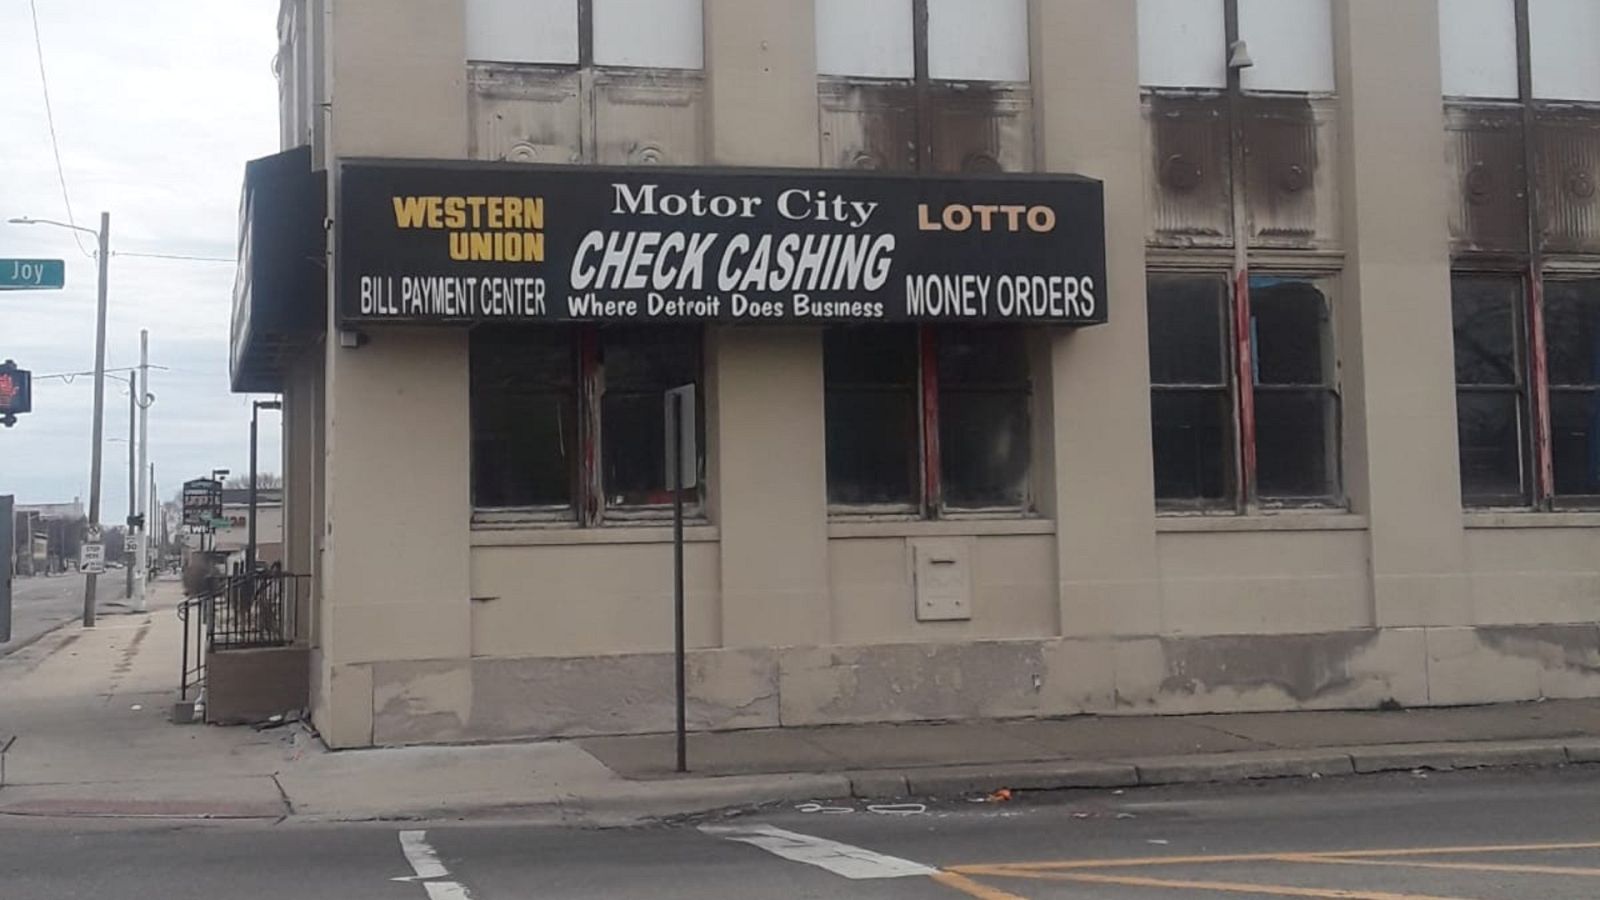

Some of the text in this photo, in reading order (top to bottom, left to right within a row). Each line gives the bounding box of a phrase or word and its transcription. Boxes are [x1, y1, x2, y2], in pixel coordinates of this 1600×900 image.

[393, 196, 544, 229] WESTERN
[612, 183, 878, 228] Motor City
[917, 203, 1057, 233] LOTTO
[450, 232, 545, 262] UNION
[569, 229, 895, 292] CHECK CASHING
[11, 261, 44, 284] Joy
[360, 275, 547, 316] BILL PAYMENT CENTER
[567, 292, 884, 319] Where Detroit Does Business
[905, 273, 1096, 318] MONEY ORDERS
